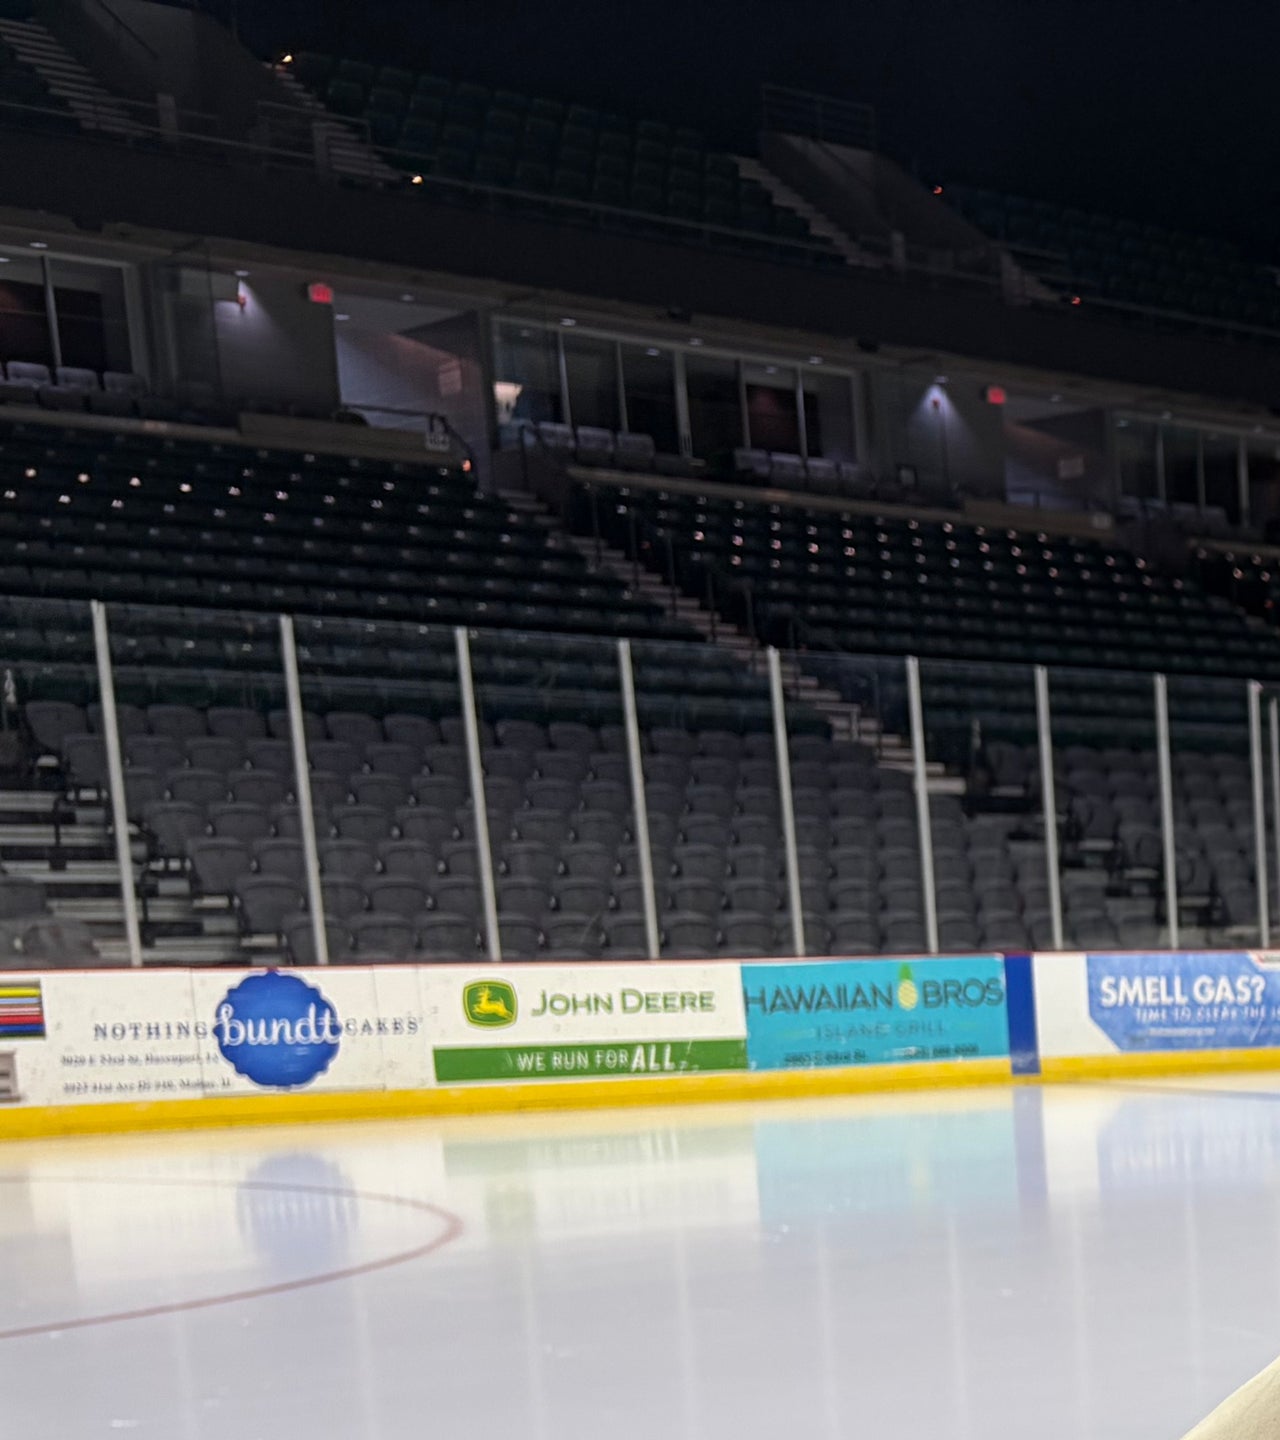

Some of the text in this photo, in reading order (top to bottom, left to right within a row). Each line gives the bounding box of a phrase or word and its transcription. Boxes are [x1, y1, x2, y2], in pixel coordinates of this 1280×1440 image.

[531, 988, 716, 1017] JOHN DEERE
[743, 977, 1004, 1015] HAWAIIAN BROS
[1101, 975, 1266, 1008] SMELL GAS?
[93, 1003, 419, 1045] NOTHING bundt CAKES
[518, 1053, 545, 1072] WE
[552, 1051, 588, 1069] RUN
[595, 1049, 628, 1068] FOR
